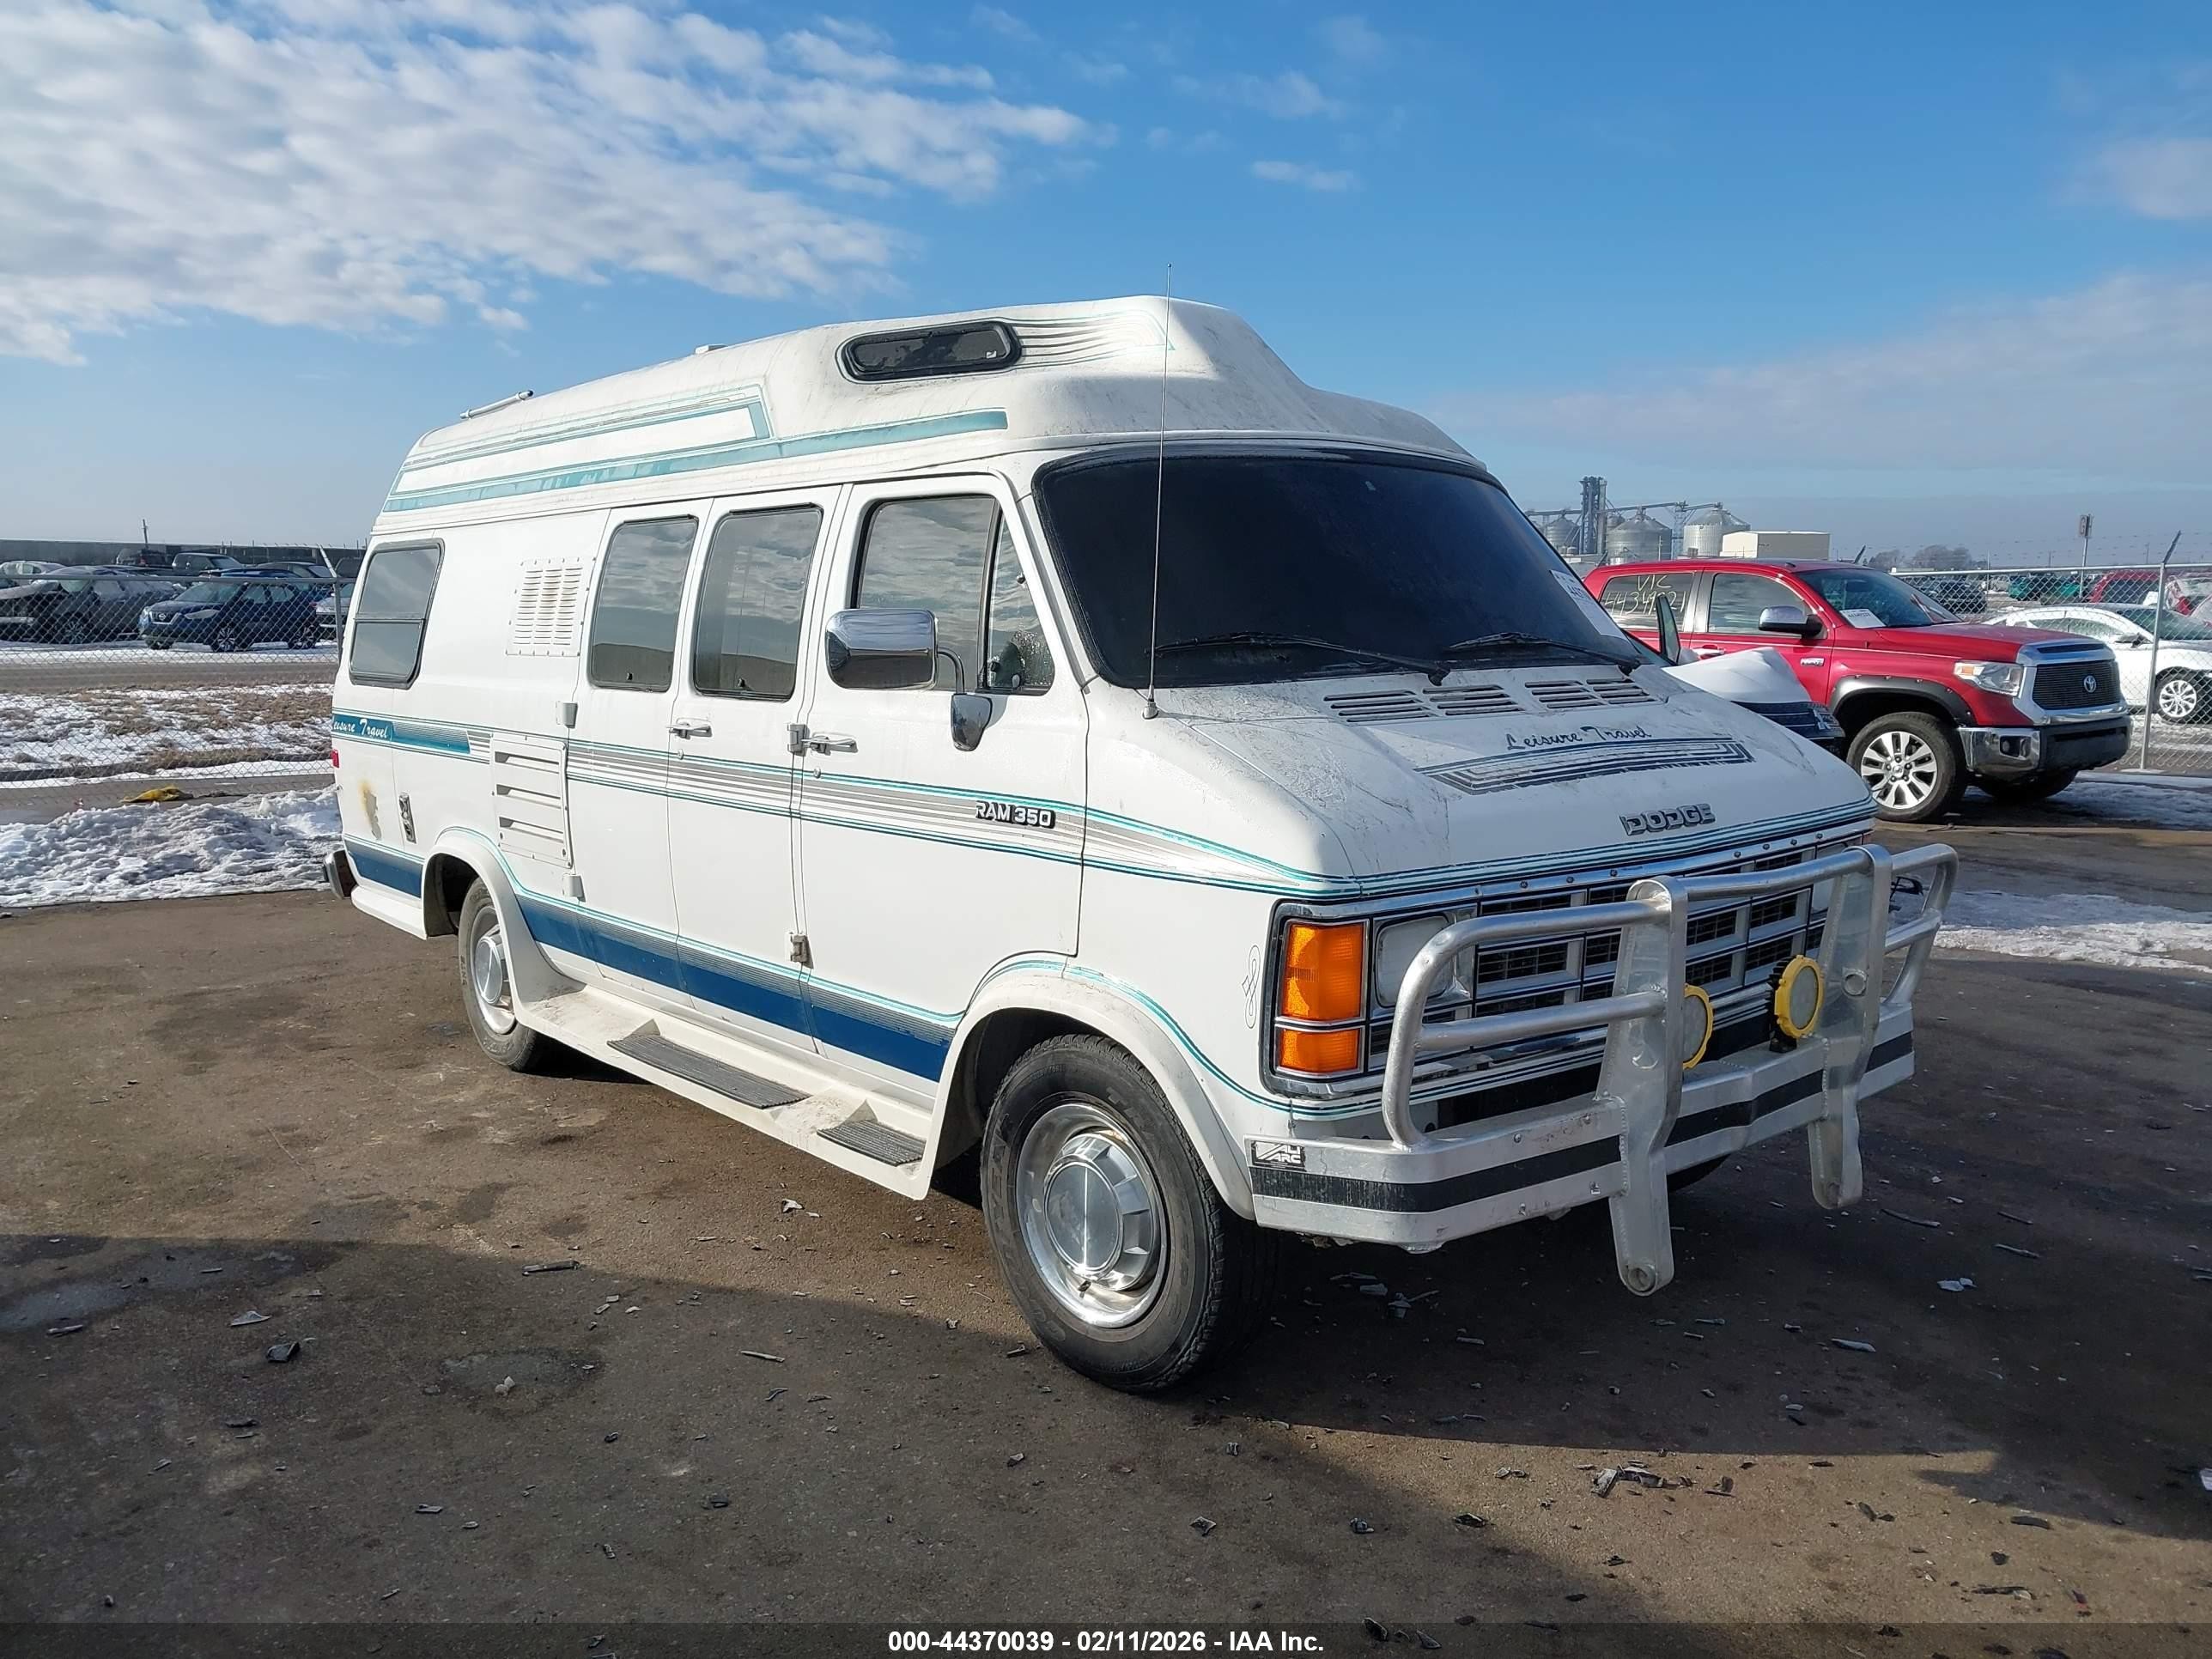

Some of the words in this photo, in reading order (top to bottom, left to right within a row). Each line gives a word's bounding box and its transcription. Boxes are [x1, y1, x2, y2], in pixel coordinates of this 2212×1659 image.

[1638, 574, 1672, 591] VIC
[1604, 591, 1686, 616] 4434921
[360, 718, 388, 738] Travel
[1506, 732, 1583, 750] Leisure
[1580, 726, 1652, 740] Travel
[975, 800, 1012, 823] RAM
[1014, 806, 1054, 829] 350
[1619, 803, 1716, 836] DODGE
